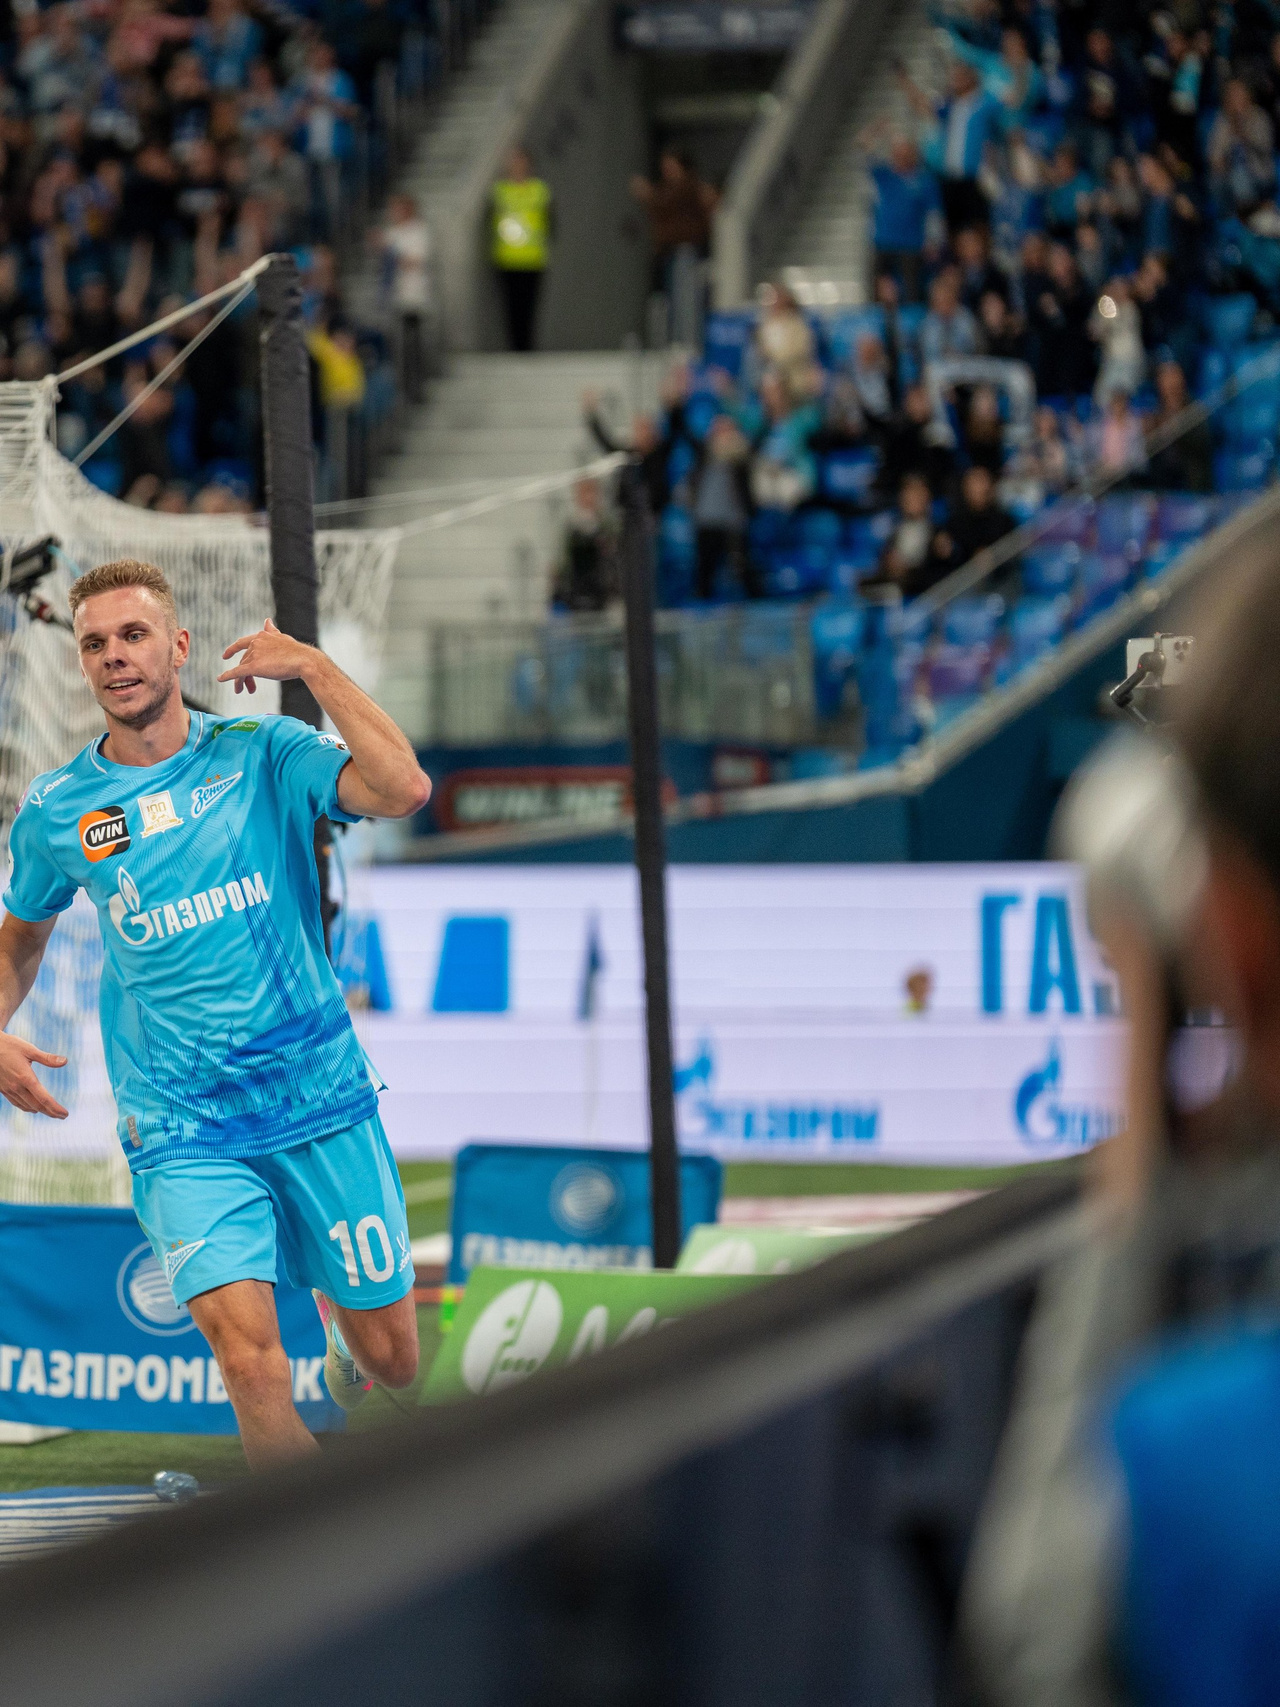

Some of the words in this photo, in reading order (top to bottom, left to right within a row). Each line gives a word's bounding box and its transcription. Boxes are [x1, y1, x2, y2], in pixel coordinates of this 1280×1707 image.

[89, 820, 124, 845] WIN
[149, 871, 270, 939] ГАЗПРОМ
[328, 1214, 395, 1287] 10
